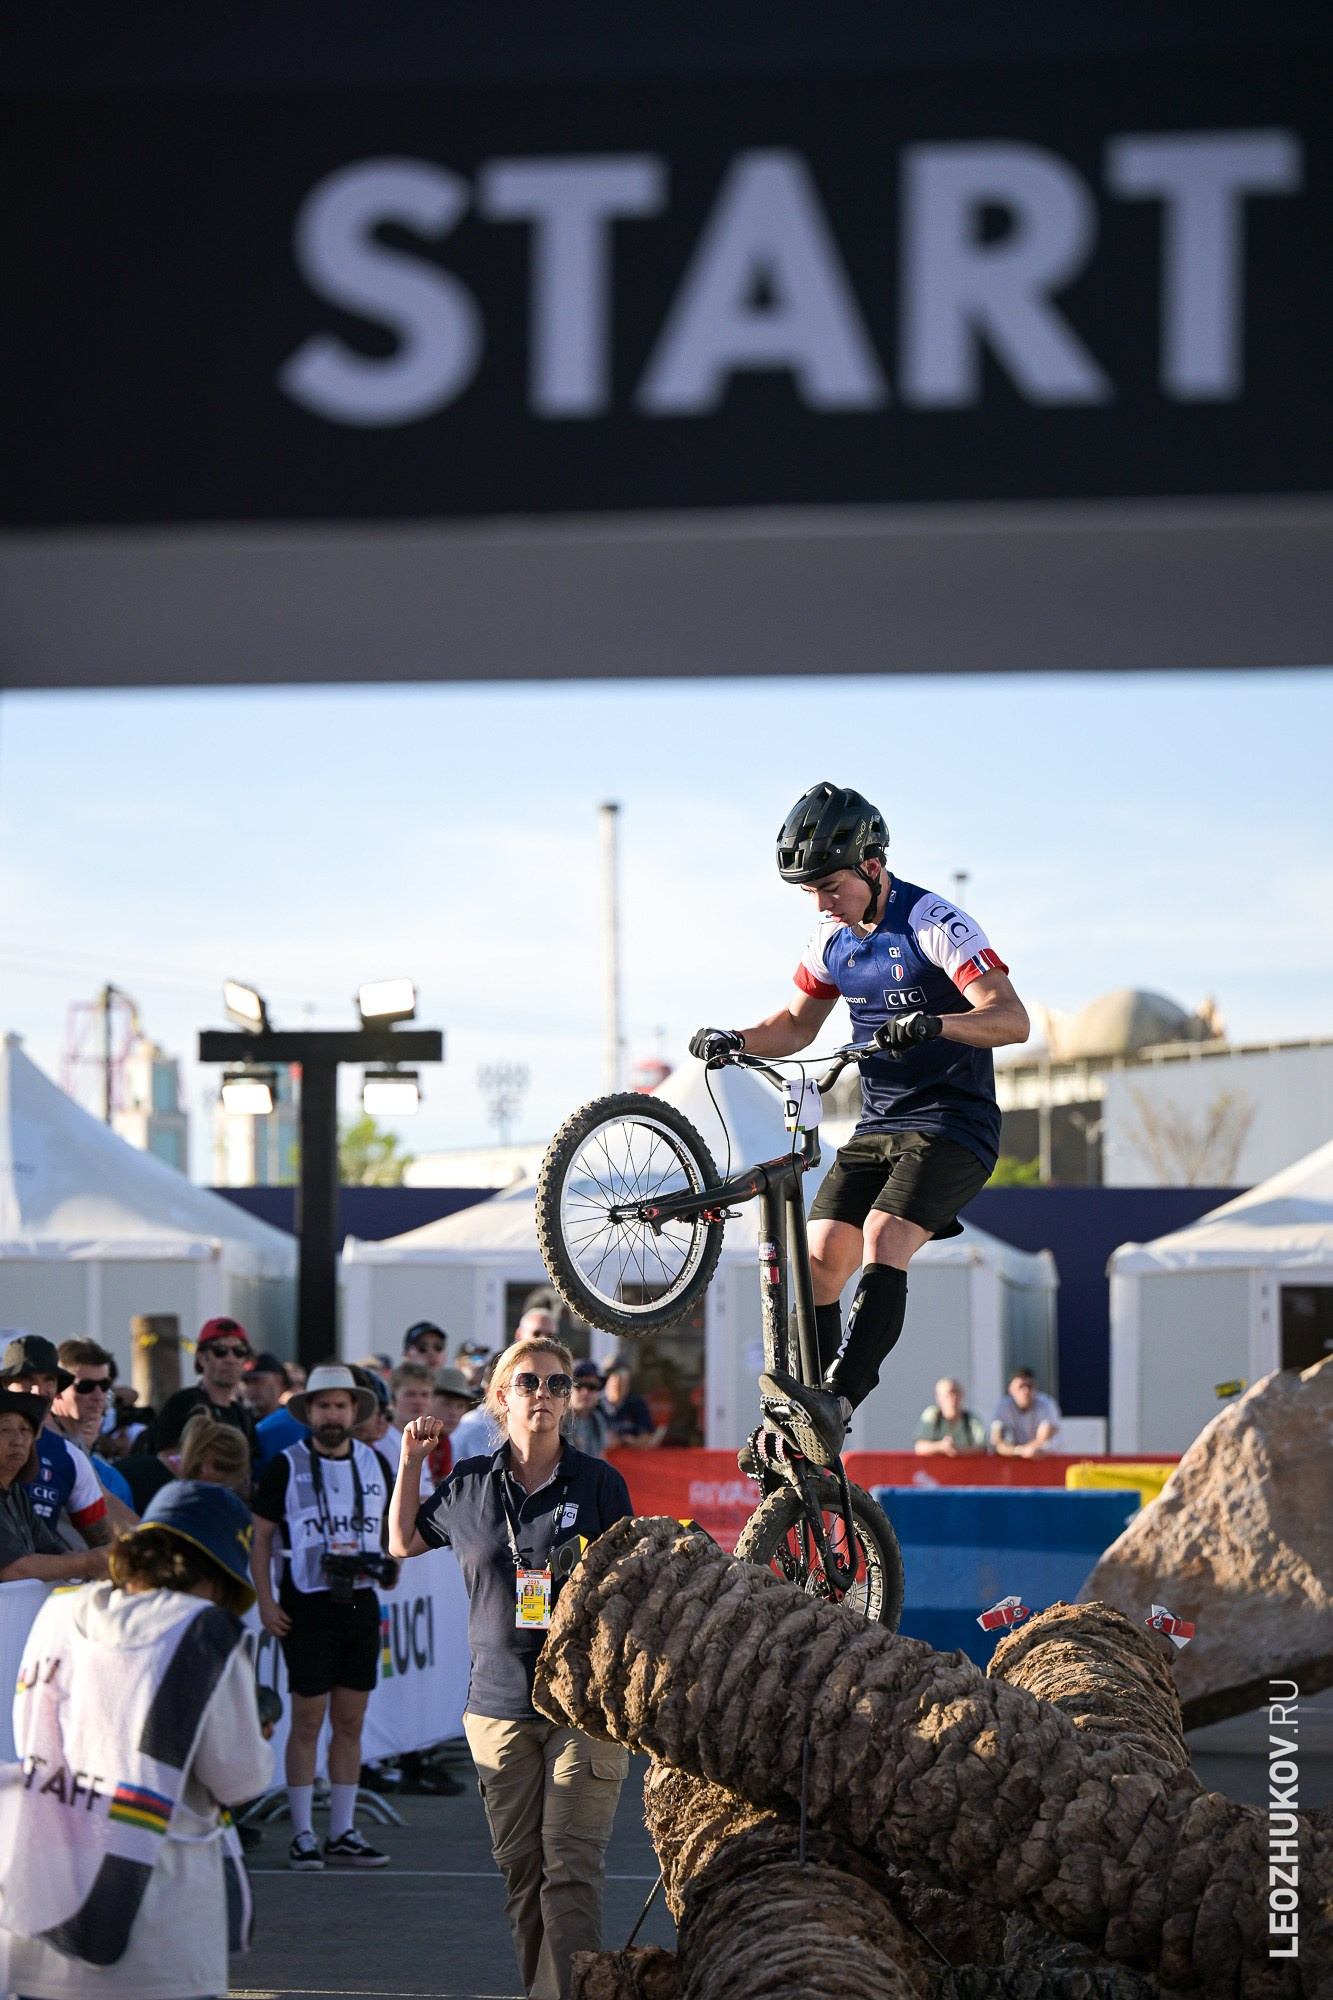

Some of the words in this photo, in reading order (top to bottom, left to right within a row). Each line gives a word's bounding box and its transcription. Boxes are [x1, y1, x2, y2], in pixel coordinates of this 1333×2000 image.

[281, 130, 1301, 428] START
[929, 905, 970, 939] CIC
[888, 991, 921, 1006] CIC
[33, 1486, 57, 1501] CIC
[391, 1595, 435, 1676] UCI
